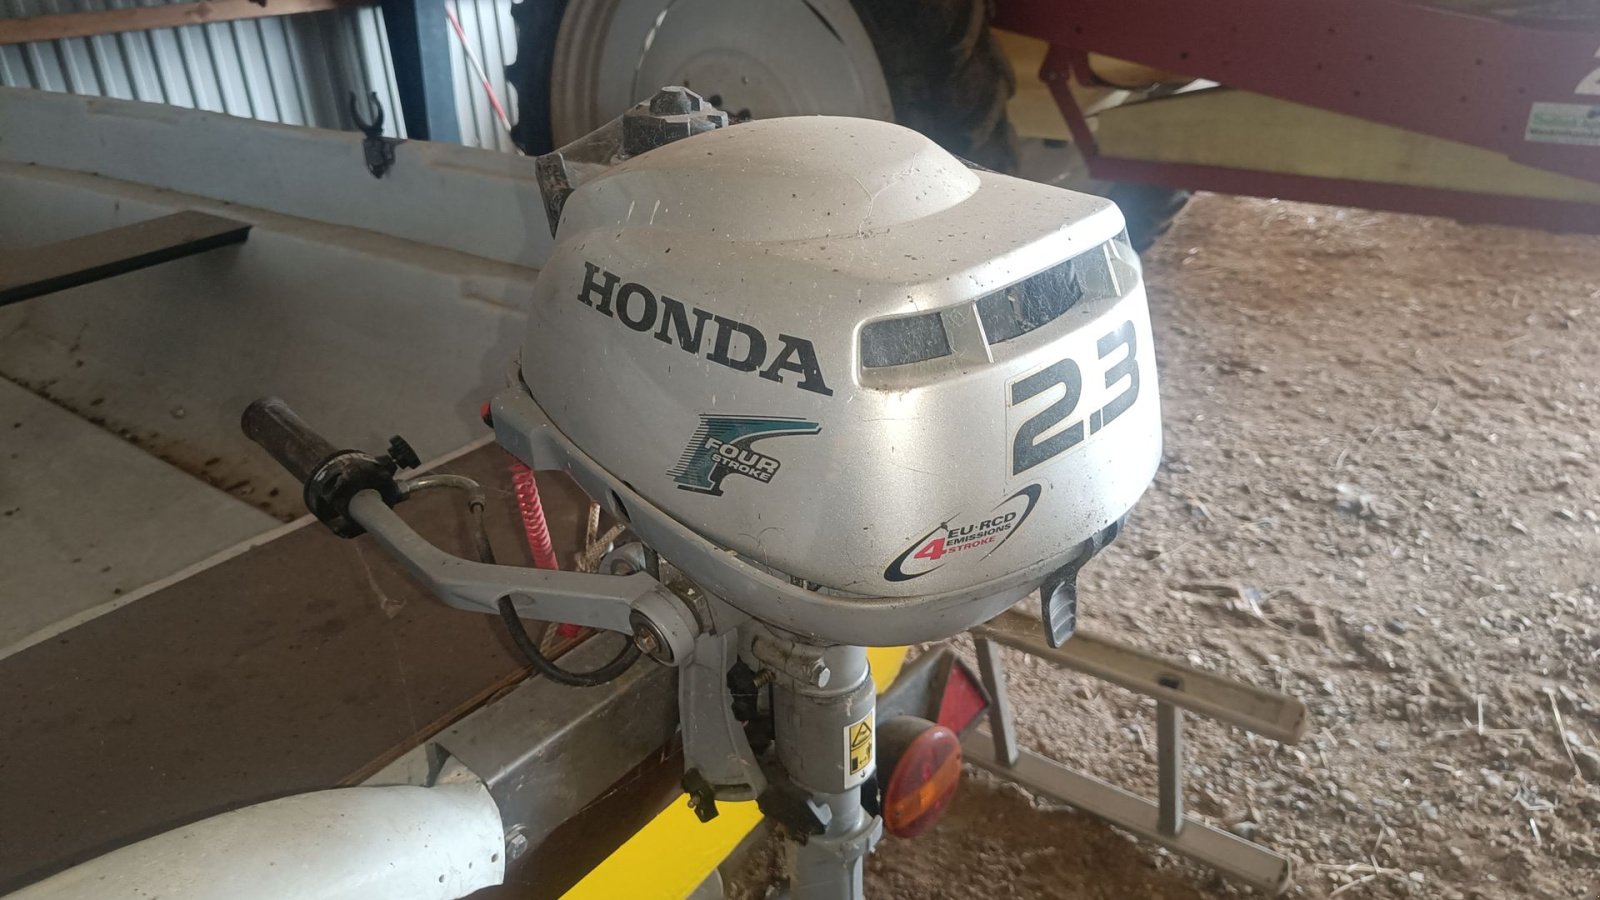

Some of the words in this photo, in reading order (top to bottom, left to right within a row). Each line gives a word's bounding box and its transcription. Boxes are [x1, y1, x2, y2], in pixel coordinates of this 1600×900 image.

[577, 260, 834, 397] HONDA
[1011, 319, 1140, 476] 2.3
[704, 437, 781, 474] FOUR
[711, 453, 771, 482] STROKE
[913, 537, 947, 561] 4
[946, 535, 997, 554] STROKE
[946, 523, 1012, 547] EMISSIONS
